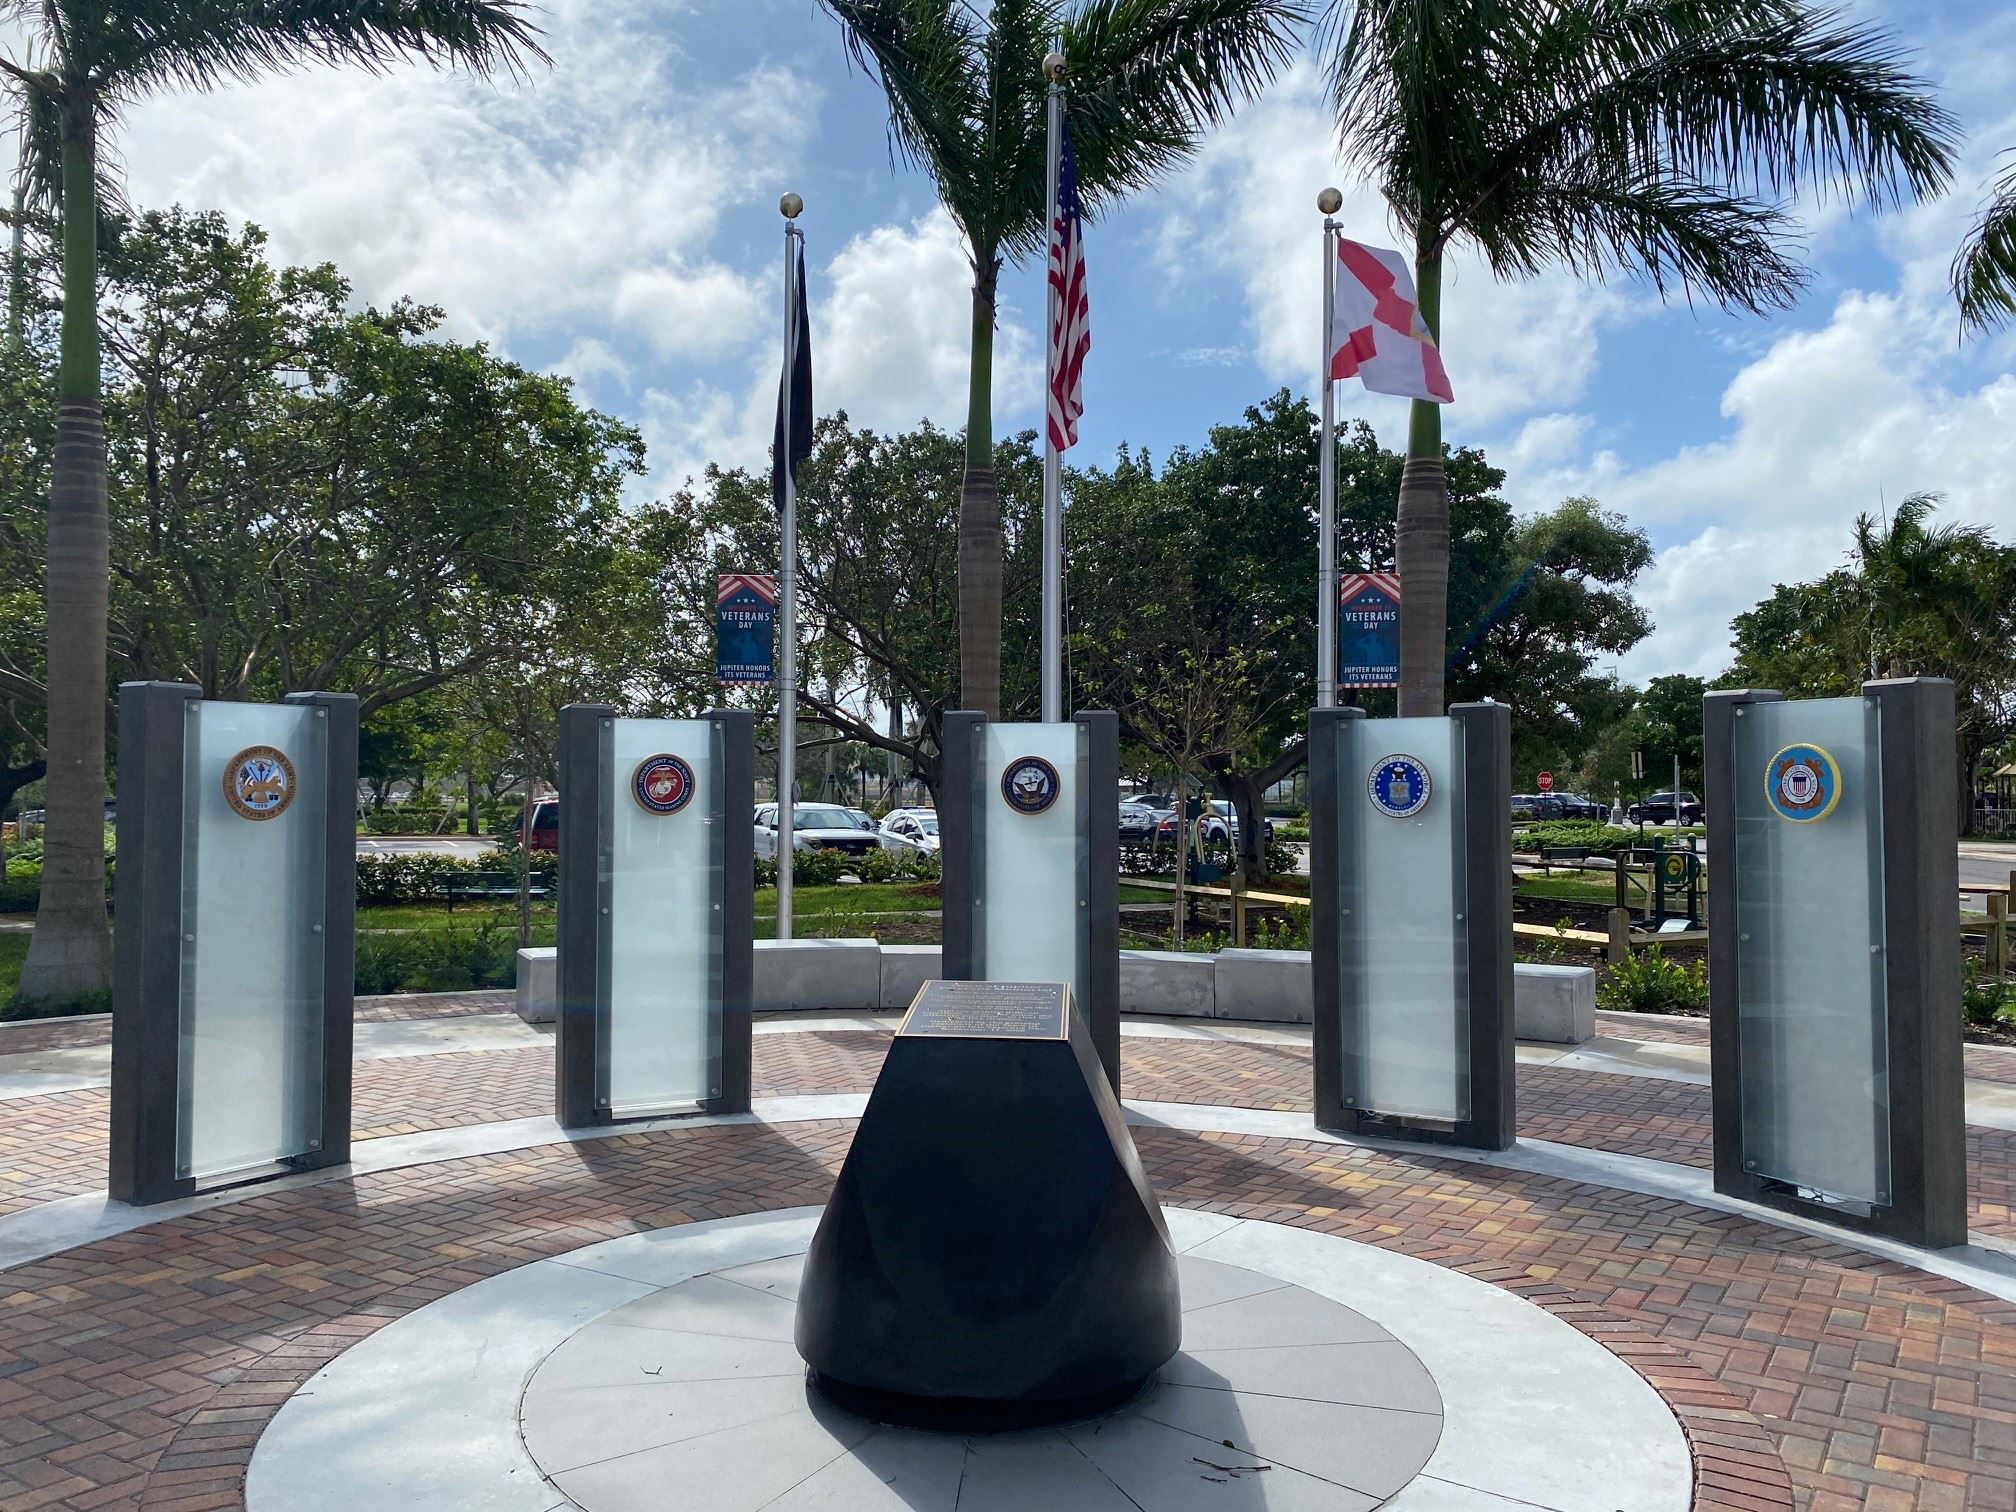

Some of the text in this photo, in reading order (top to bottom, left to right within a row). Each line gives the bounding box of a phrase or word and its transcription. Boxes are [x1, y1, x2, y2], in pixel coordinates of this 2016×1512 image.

[721, 611, 770, 622] VETERANS
[1345, 611, 1396, 622] VETERANS
[738, 621, 752, 629] DAY
[745, 664, 770, 672] HONORS
[1344, 666, 1370, 674] JUPITER
[638, 758, 667, 783] DEPARTMENT
[681, 768, 690, 783] NAVY
[1538, 777, 1552, 785] STOP
